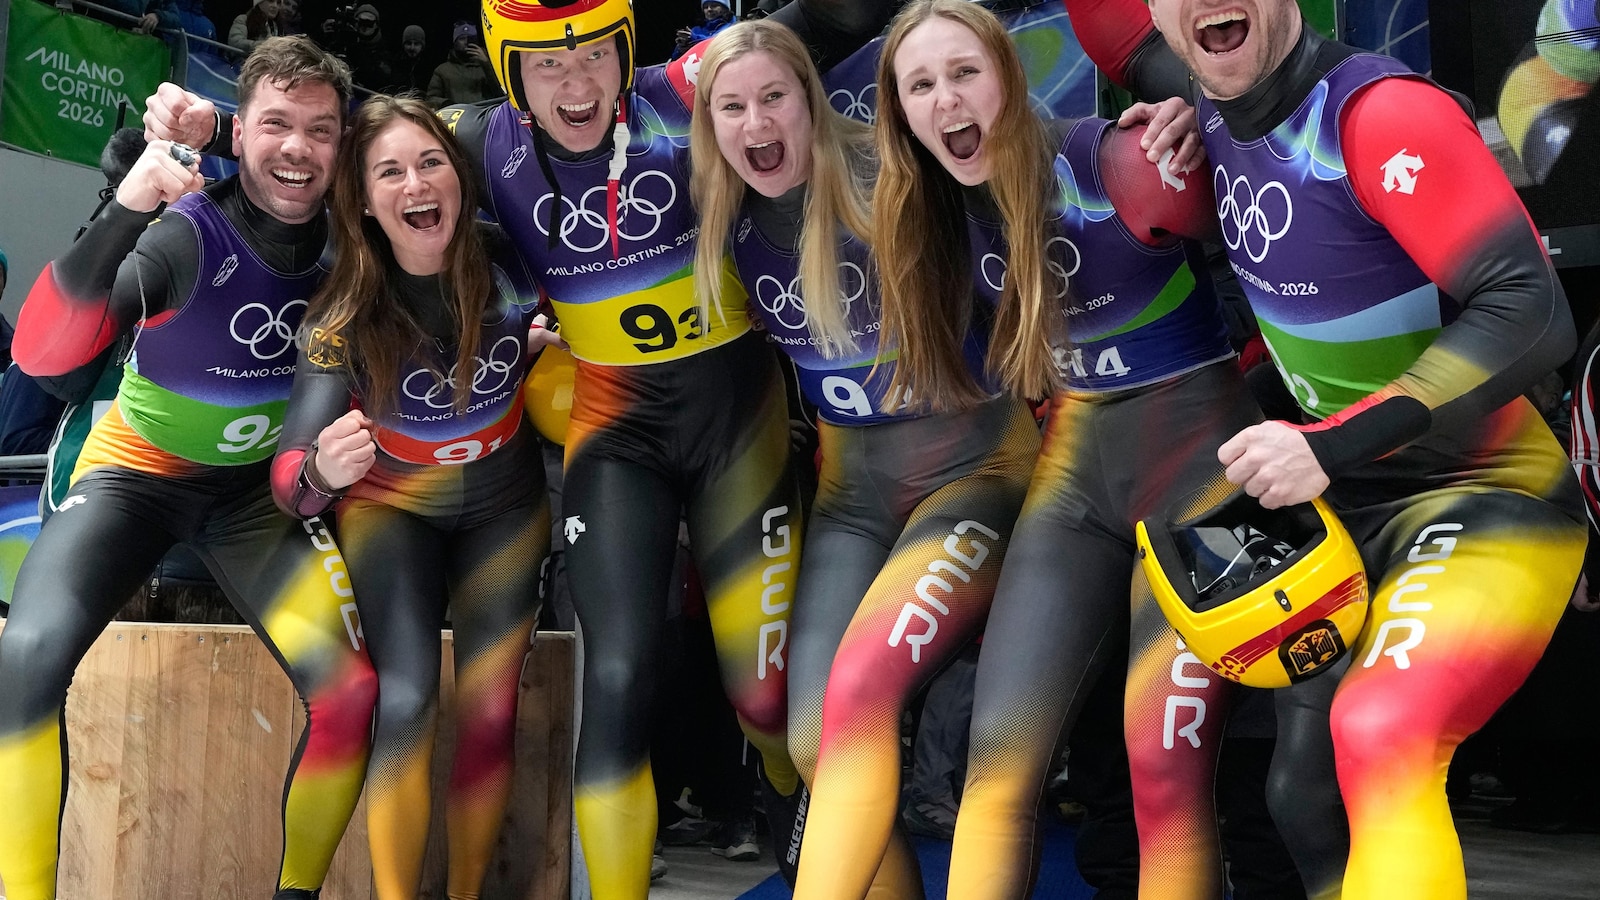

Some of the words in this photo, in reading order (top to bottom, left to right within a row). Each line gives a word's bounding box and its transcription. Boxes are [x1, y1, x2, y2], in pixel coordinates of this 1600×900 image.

[25, 47, 125, 87] MILANO
[41, 71, 139, 116] CORTINA
[58, 100, 105, 128] 2026
[546, 261, 604, 277] MILANO
[606, 243, 674, 270] CORTINA
[675, 226, 700, 247] 2026
[1086, 292, 1115, 311] 2026
[1241, 267, 1279, 295] CORTINA
[1280, 282, 1319, 296] 2026
[770, 333, 806, 346] MILANO
[206, 366, 270, 379] MILANO
[392, 411, 453, 422] MILANO
[455, 390, 511, 416] CORTINA
[757, 505, 791, 680] GER
[887, 519, 1000, 663] GER
[1362, 523, 1464, 670] GER
[786, 785, 808, 866] SKECHER
